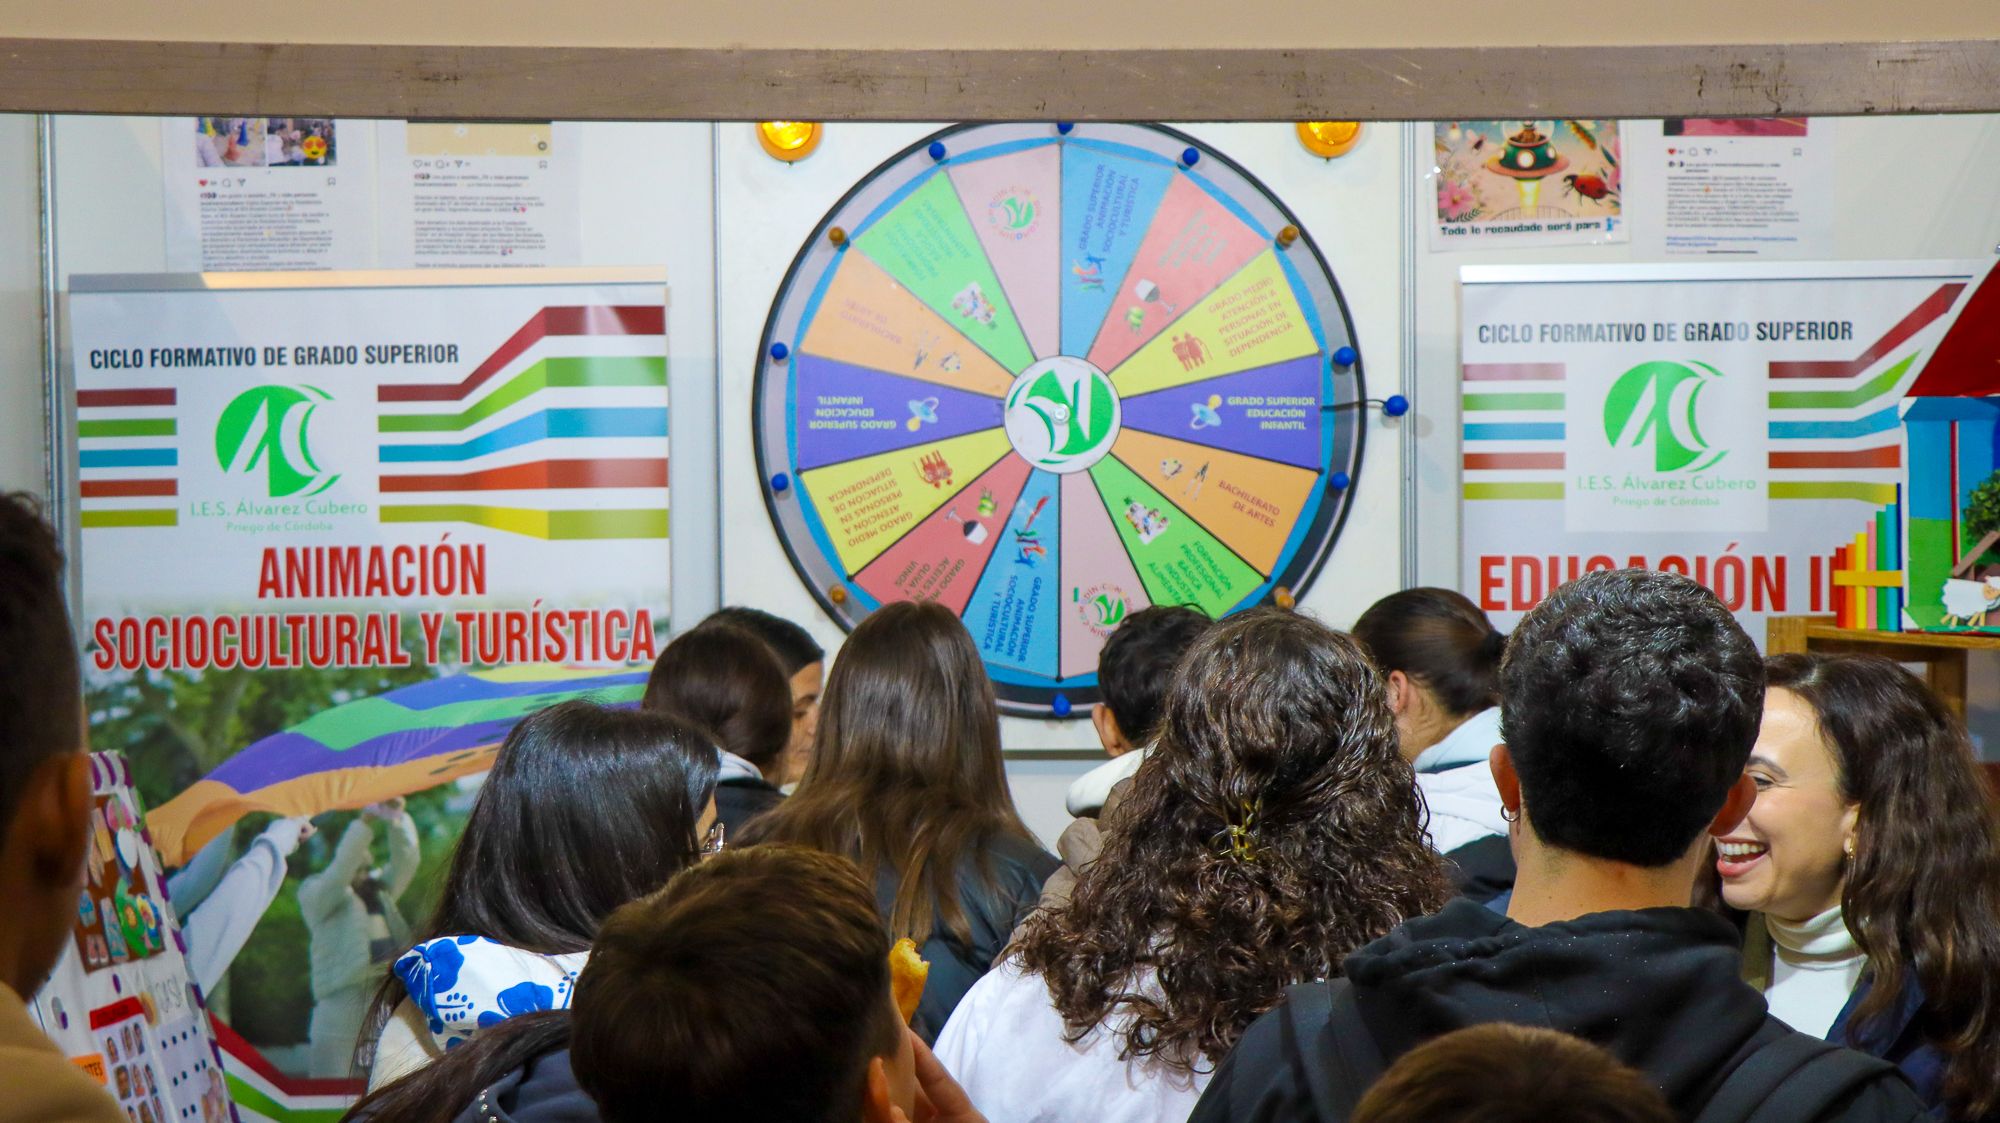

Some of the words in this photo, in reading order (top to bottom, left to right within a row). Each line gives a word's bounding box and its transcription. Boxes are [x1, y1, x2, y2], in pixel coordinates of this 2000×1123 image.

[1079, 215, 1094, 250] GRADO
[1087, 164, 1106, 213] SUPERIOR
[1103, 175, 1129, 253] SOCIOCULTURAL
[1208, 293, 1242, 314] GRADO
[1243, 277, 1274, 297] MEDIO
[1269, 289, 1278, 298] A
[1218, 306, 1267, 335] PERSONAS
[1269, 300, 1282, 311] EN
[1230, 322, 1294, 358] DEPENDENCIA
[1479, 324, 1533, 344] CICLO
[1540, 323, 1647, 343] FORMATIVO
[1653, 323, 1678, 342] DE
[1684, 322, 1749, 342] GRADO
[1756, 321, 1853, 341] SUPERIOR
[90, 349, 144, 369] CICLO
[150, 347, 256, 368] FORMATIVO
[263, 347, 288, 366] DE
[294, 346, 358, 366] GRADO
[365, 344, 459, 365] SUPERIOR
[817, 396, 863, 405] INFANTIL
[1227, 396, 1265, 406] GRADO
[1266, 396, 1316, 406] SUPERIOR
[809, 420, 858, 430] SUPERIOR
[861, 420, 897, 430] GRADO
[1260, 420, 1307, 430] INFANTIL
[828, 467, 893, 503] DEPENDENCIA
[1577, 475, 1617, 490] I.E.S.
[1623, 471, 1686, 490] Álvarez
[1692, 474, 1757, 490] Cubero
[190, 500, 231, 517] I.E.S.
[236, 497, 300, 516] Álvarez
[305, 499, 368, 515] Cubero
[833, 504, 846, 514] DE
[853, 489, 903, 519] PERSONAS
[1218, 479, 1281, 517] BACHILERATO
[1653, 495, 1667, 506] de
[267, 520, 281, 532] de
[840, 515, 852, 524] EN
[880, 510, 914, 533] GRADO
[1233, 500, 1245, 513] DE
[1247, 506, 1276, 528] ARTES
[844, 527, 851, 535] A
[848, 525, 879, 548] MEDIO
[258, 532, 487, 599] ANIMACIÓN
[894, 560, 918, 587] VINOS
[922, 557, 950, 592] ACEITES
[940, 559, 965, 591] GRADO
[1180, 543, 1225, 600] PROFESIONAL
[1029, 576, 1042, 613] GRADO
[995, 575, 1018, 653] SOCIOCULTURAL
[93, 611, 410, 671] SOCIOCULTURAL
[418, 611, 447, 664] Y
[455, 600, 658, 664] TURÍSTICA
[1018, 613, 1035, 663] SUPERIOR
